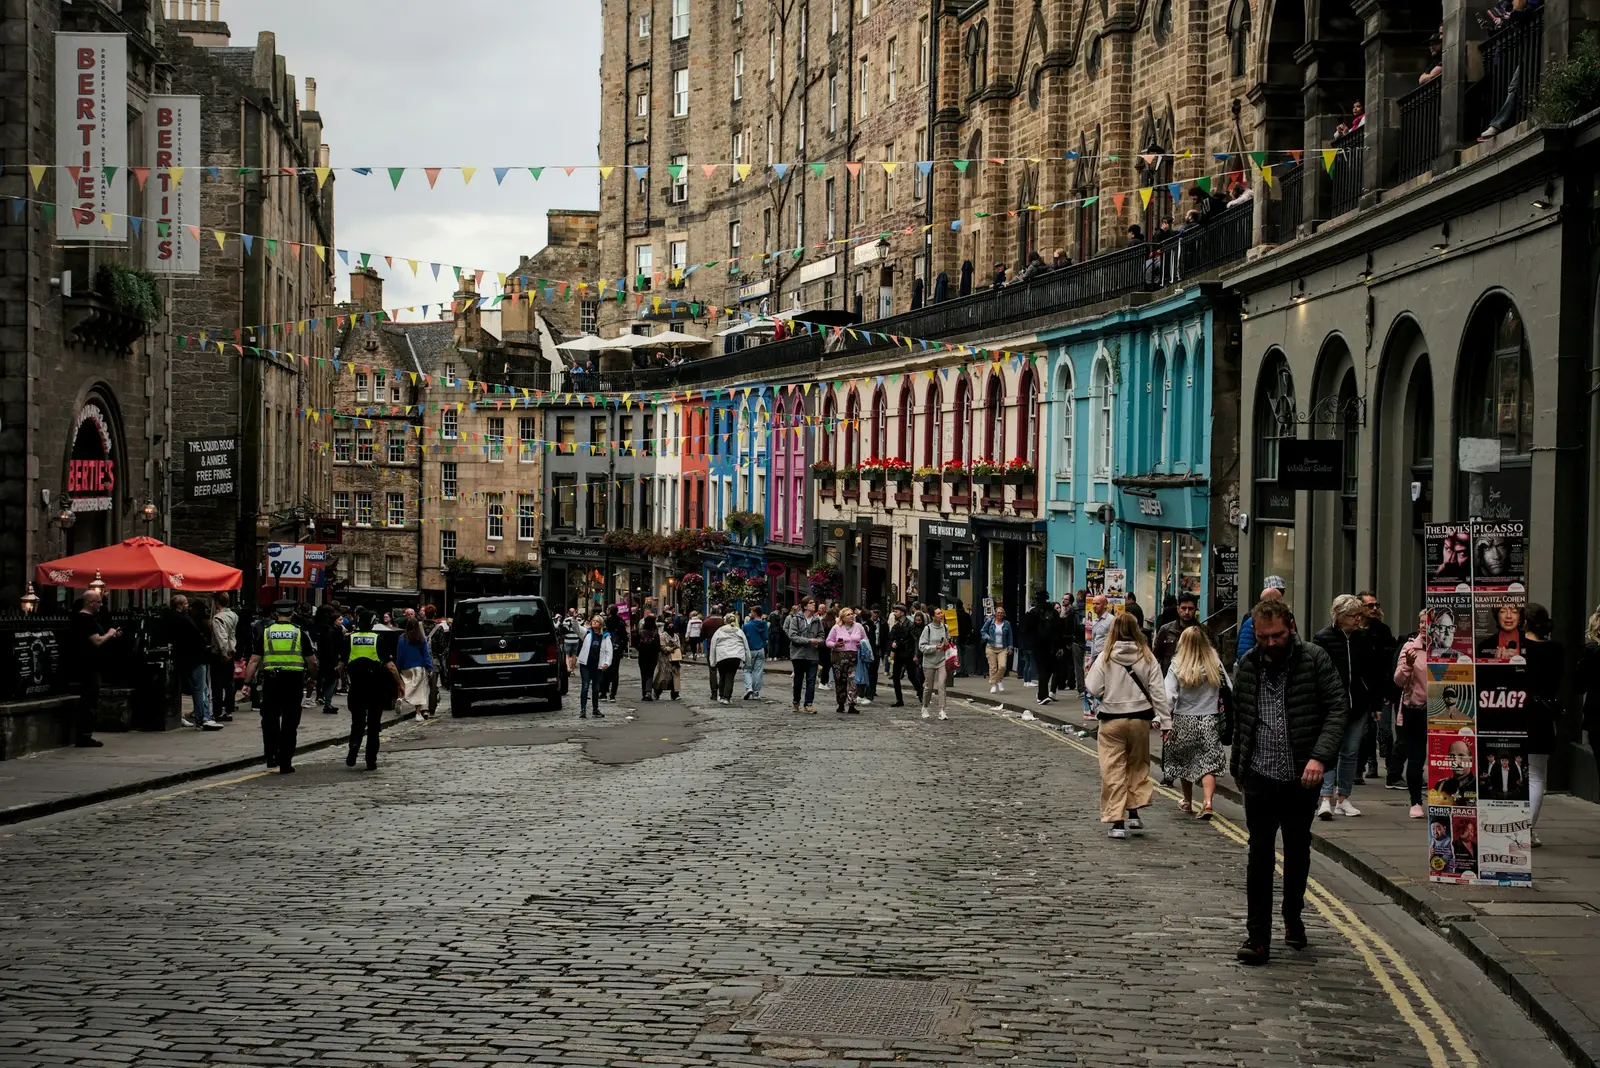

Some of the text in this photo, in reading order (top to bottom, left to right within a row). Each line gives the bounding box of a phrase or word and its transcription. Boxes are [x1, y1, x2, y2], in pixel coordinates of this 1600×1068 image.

[77, 47, 97, 225] BERTIES
[188, 439, 235, 452] THE LIQUID ROOM
[201, 454, 228, 467] & ANNEXE
[1286, 463, 1334, 472] Walker Slater
[67, 459, 115, 492] BERTIE'S
[196, 468, 232, 481] FREE FRINGE
[194, 482, 234, 497] BEER GARDEN
[928, 525, 967, 537] THE WHISKY SHOP
[1426, 523, 1470, 534] THE DEVIL'S
[1473, 523, 1524, 533] PICASSO
[1427, 596, 1472, 604] MANIFEST
[1474, 595, 1526, 604] KRAVITZ, COHEN
[270, 631, 294, 639] POLICE
[353, 637, 375, 645] POLICE
[1479, 690, 1527, 709] SLAG?
[1484, 818, 1532, 834] CUTTING
[1482, 854, 1520, 865] EDGE
